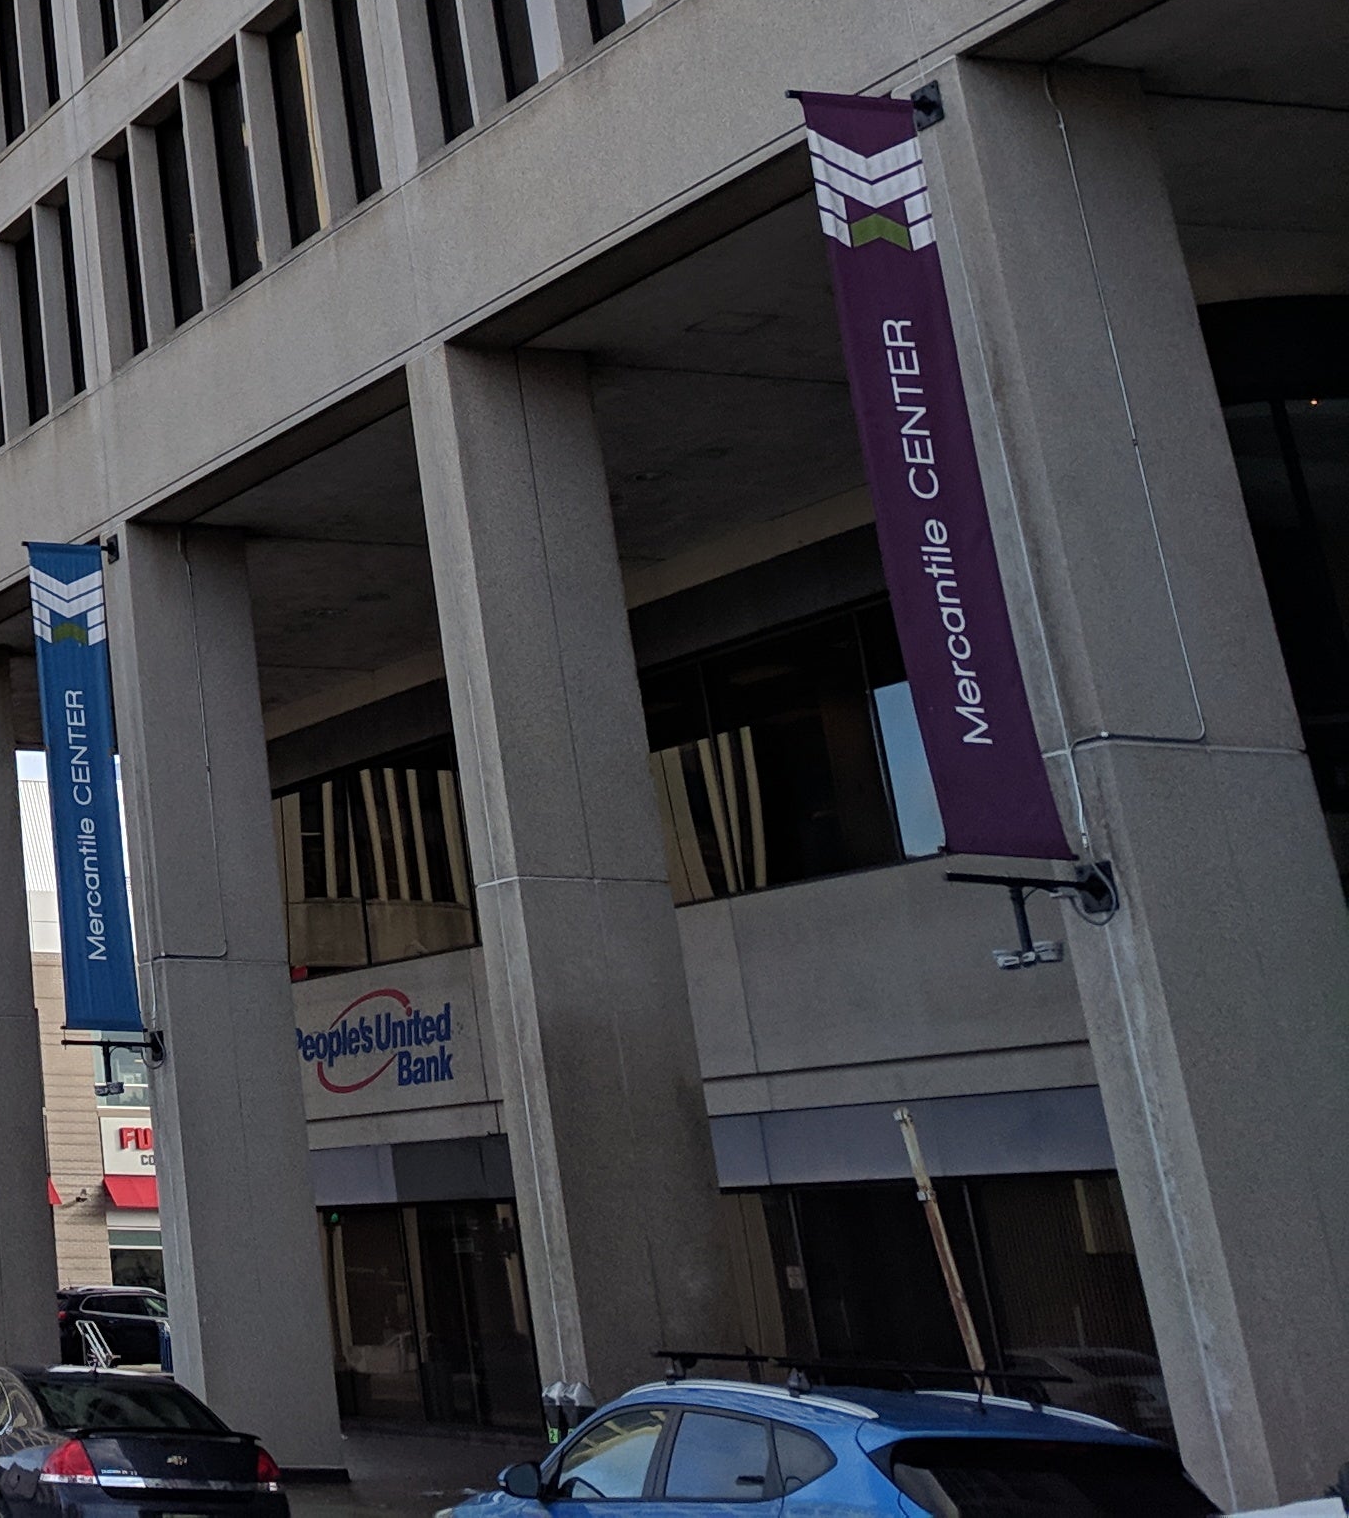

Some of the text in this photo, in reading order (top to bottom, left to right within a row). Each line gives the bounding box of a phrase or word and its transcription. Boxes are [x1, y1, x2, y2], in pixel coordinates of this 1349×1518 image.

[883, 318, 993, 745] Mercantile CENTER
[65, 690, 107, 961] Mercantile CENTER
[375, 1002, 451, 1052] United
[398, 1045, 454, 1086] Bank
